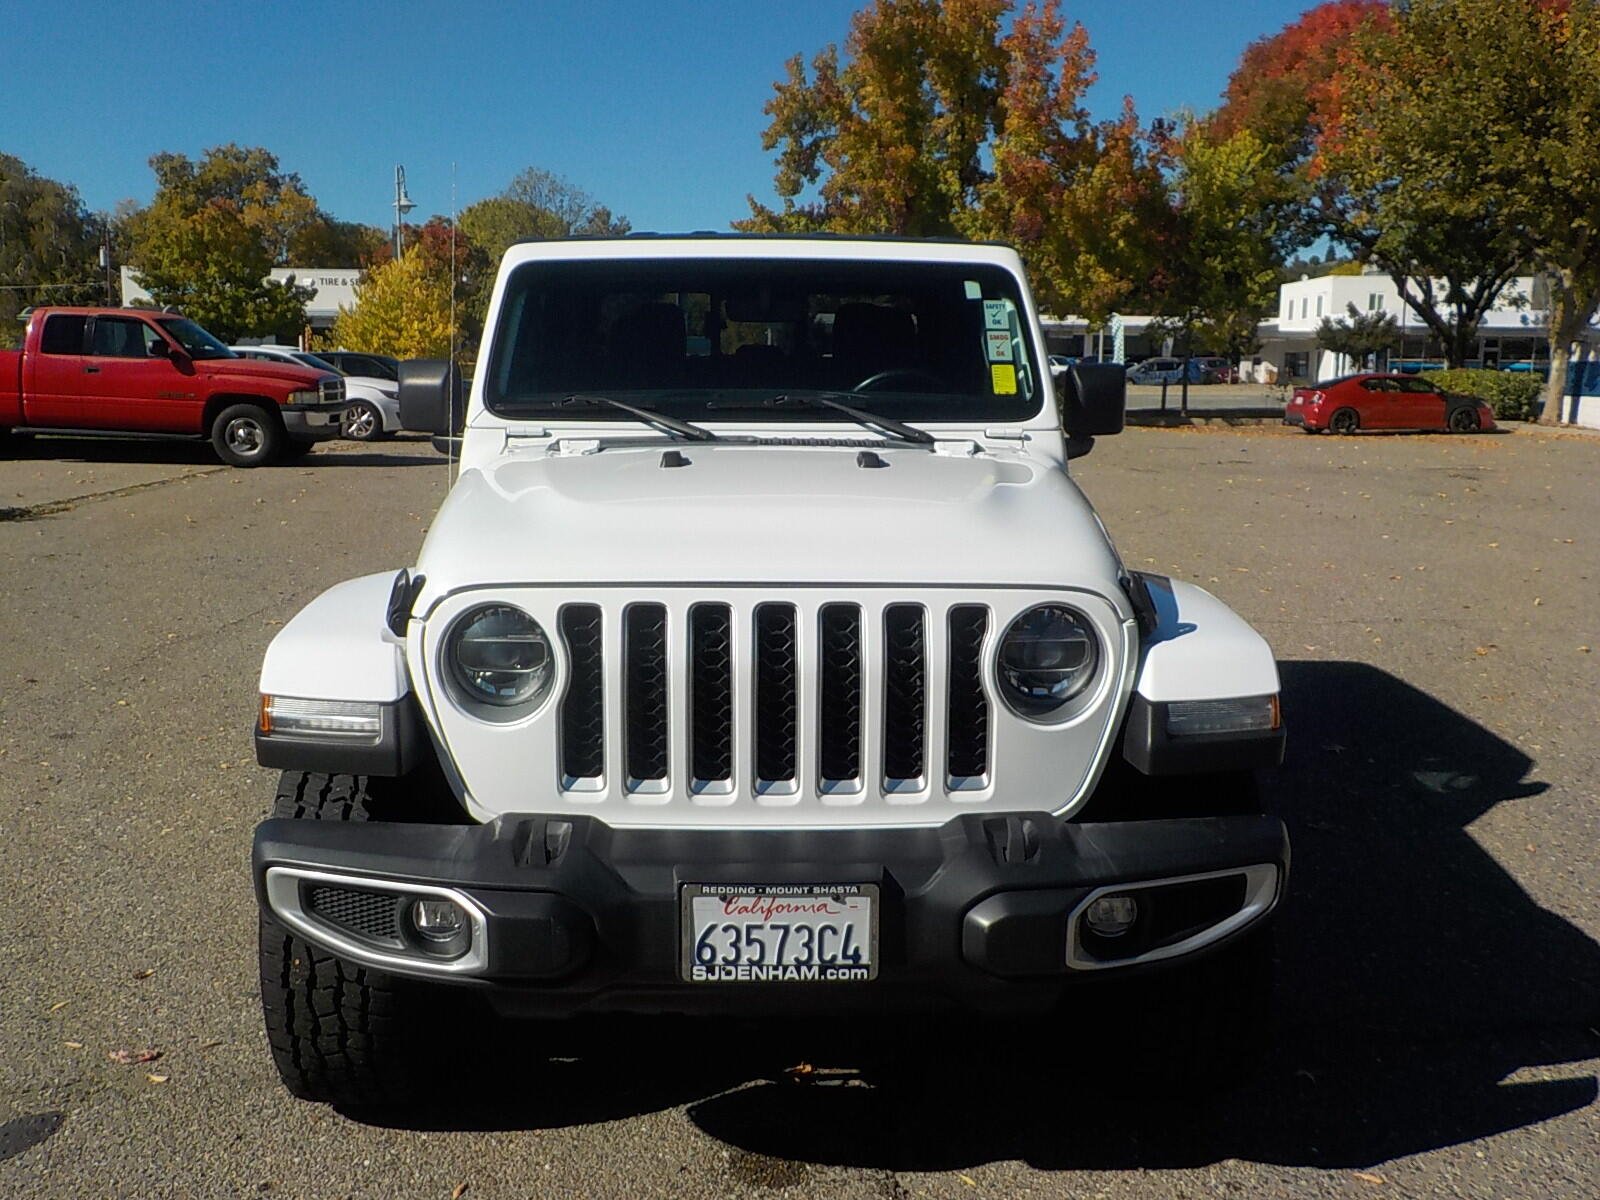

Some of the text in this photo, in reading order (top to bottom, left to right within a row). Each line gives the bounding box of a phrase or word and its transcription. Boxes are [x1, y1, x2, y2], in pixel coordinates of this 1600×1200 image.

[319, 277, 338, 286] TIRE
[341, 278, 347, 286] &
[702, 886, 858, 894] REDDING MOUNT SHASTA
[723, 896, 840, 921] California
[695, 922, 862, 965] 63573C4
[692, 966, 868, 981] SJDENHAM.com
